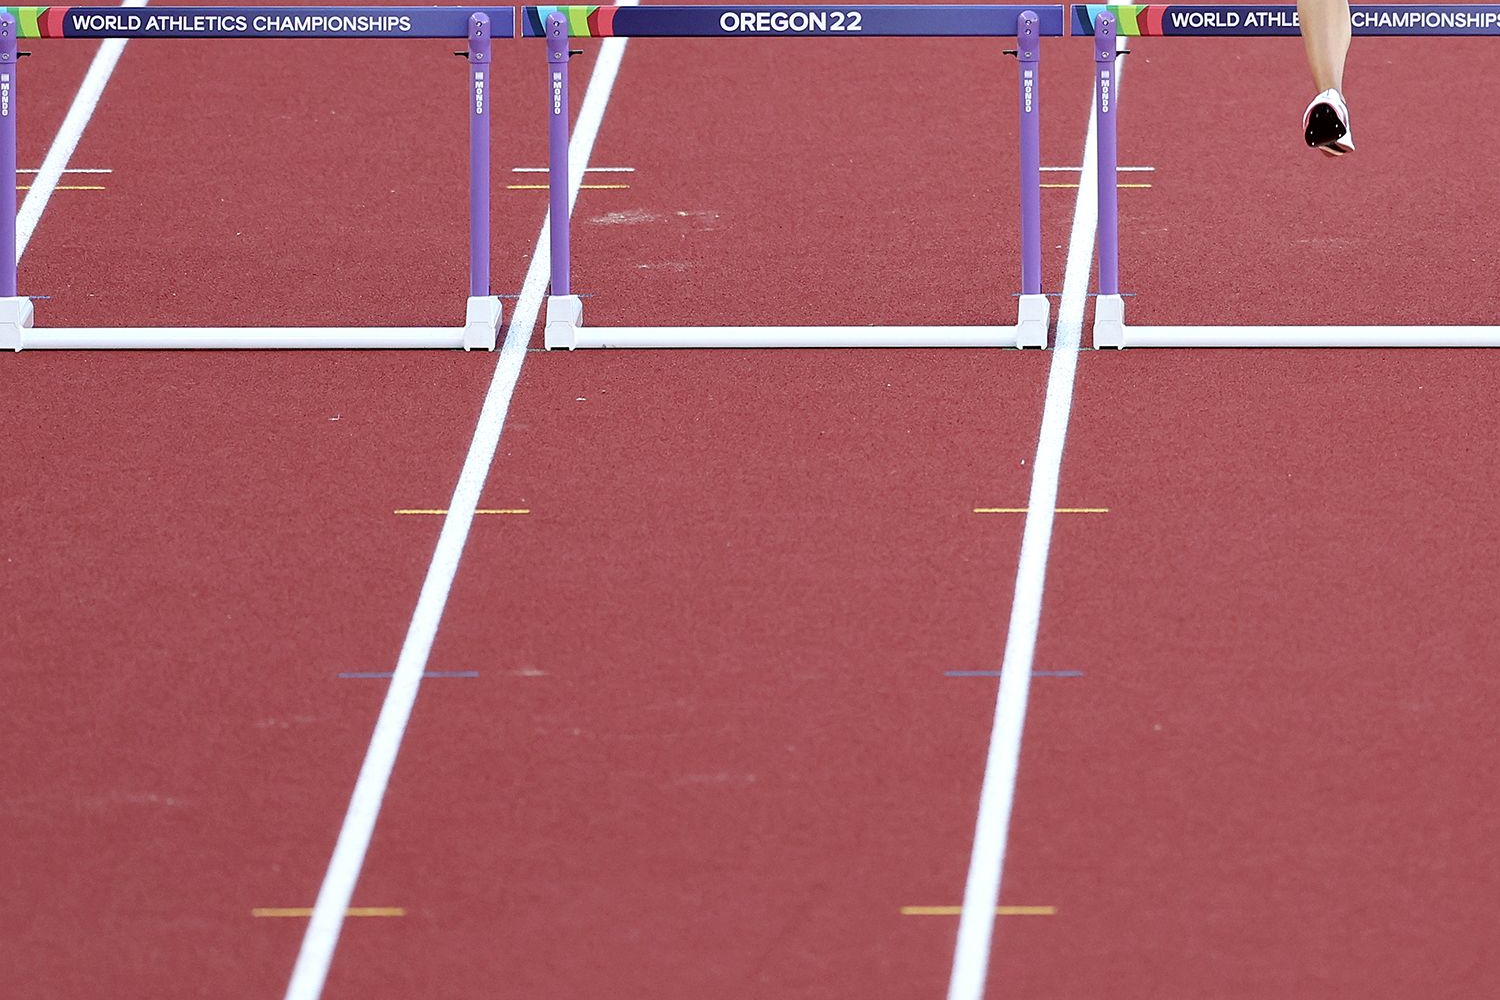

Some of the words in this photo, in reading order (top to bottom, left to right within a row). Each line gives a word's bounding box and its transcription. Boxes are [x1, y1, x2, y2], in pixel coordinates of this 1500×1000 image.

[72, 14, 142, 31] WORLD
[145, 14, 248, 31] ATHLETICS
[252, 14, 413, 32] CHAMPIONSHIPS
[1171, 12, 1240, 28] WORLD
[1243, 11, 1300, 28] ATHLE
[0, 83, 10, 117] MONDO
[474, 80, 485, 115] MONDO
[553, 81, 563, 116] MONDO
[1023, 79, 1034, 114] MONDO
[1100, 79, 1111, 114] MONDO
